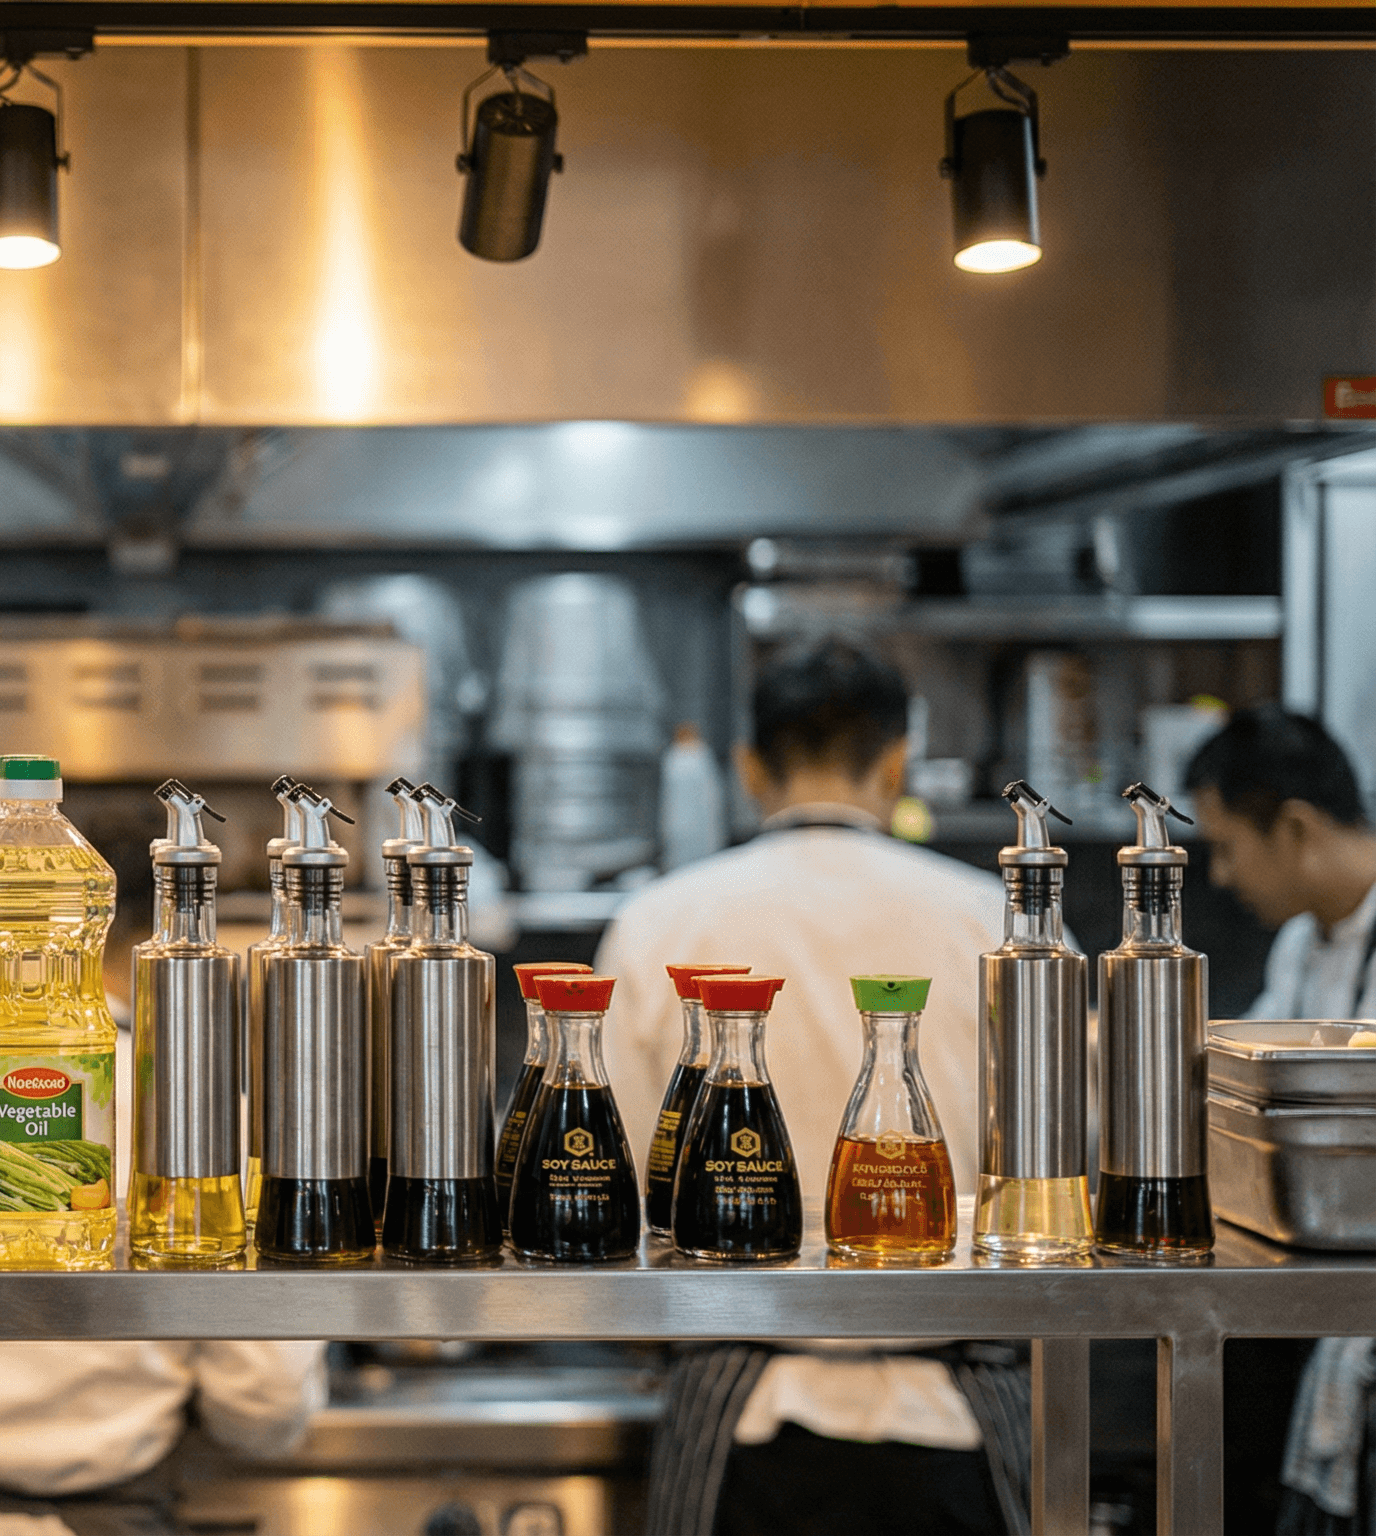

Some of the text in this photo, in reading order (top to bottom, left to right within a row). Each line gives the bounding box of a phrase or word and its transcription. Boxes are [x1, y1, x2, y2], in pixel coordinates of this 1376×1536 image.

[25, 1120, 48, 1136] Oil
[542, 1159, 616, 1170] SOY SAUCE
[705, 1160, 783, 1173] SOY SAUCE
